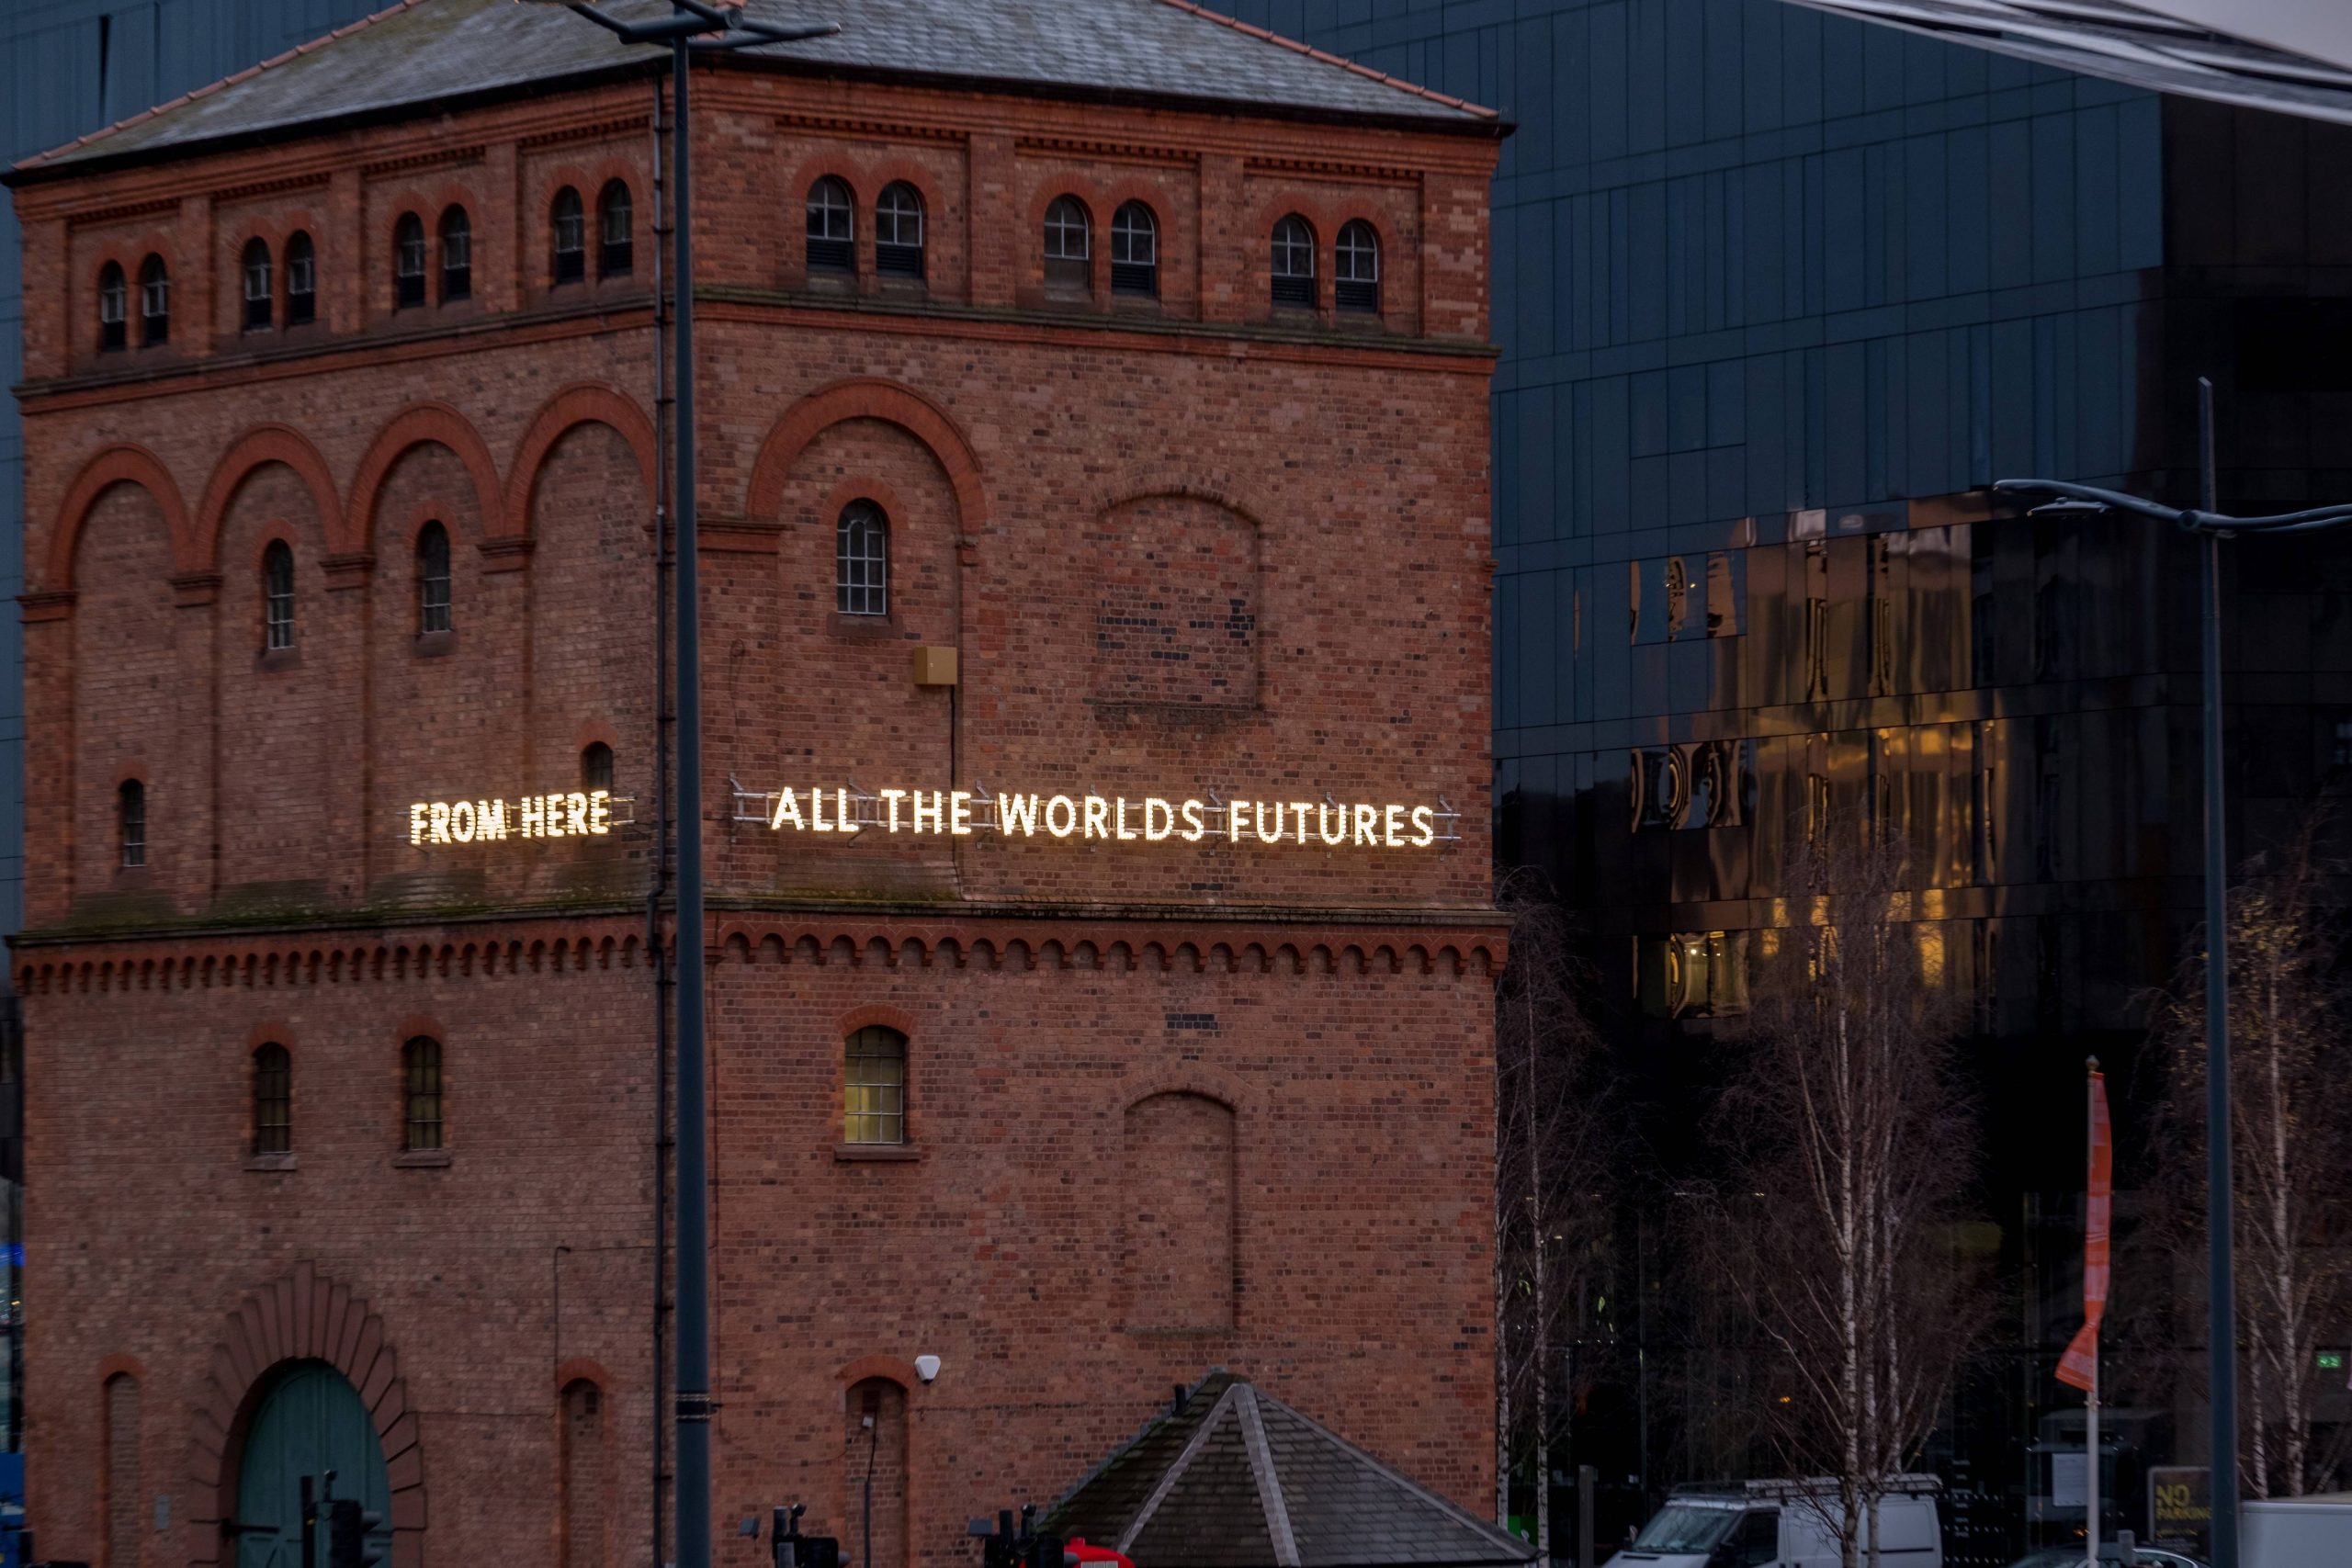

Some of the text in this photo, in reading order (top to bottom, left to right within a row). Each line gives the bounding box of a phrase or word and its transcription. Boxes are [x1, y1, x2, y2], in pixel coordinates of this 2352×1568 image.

[411, 791, 608, 844] FROM HERE
[771, 787, 1435, 847] ALL THE WORLDS FUTURES
[2155, 1483, 2190, 1507] NO
